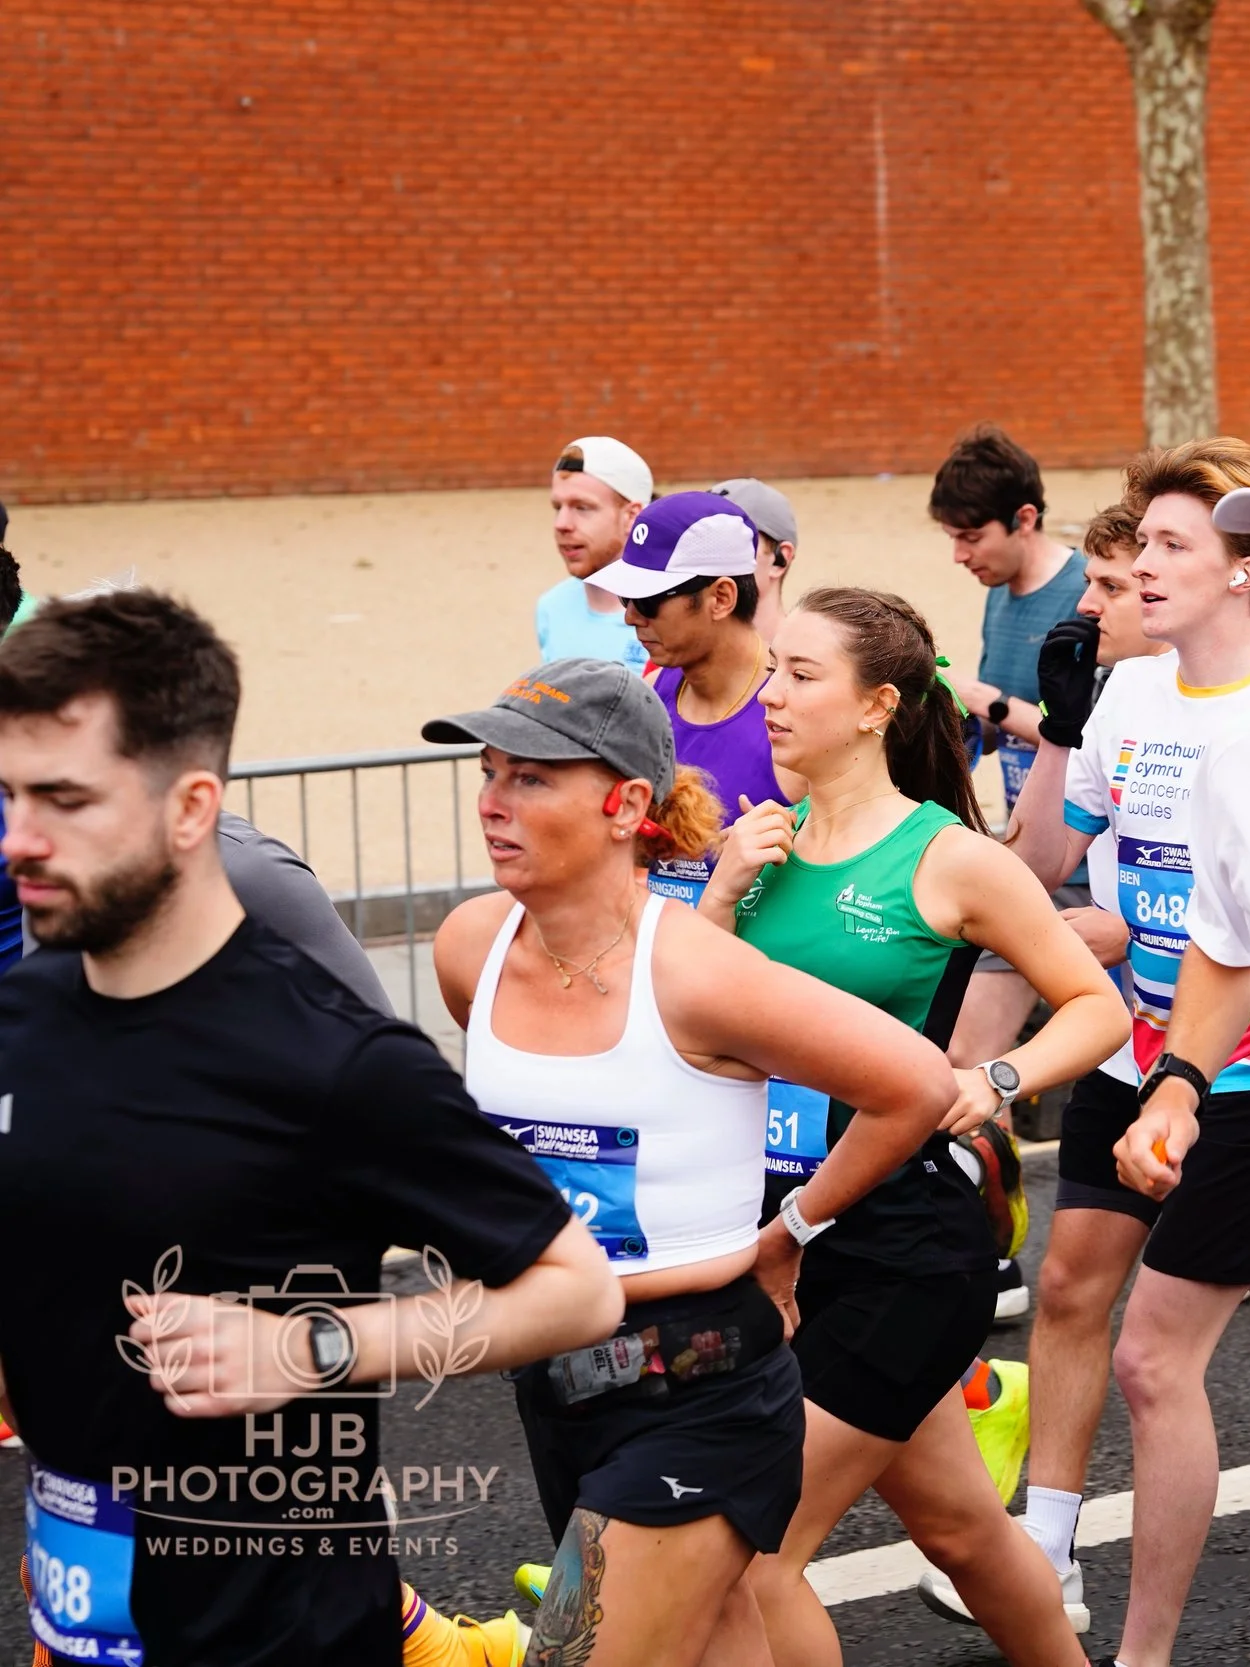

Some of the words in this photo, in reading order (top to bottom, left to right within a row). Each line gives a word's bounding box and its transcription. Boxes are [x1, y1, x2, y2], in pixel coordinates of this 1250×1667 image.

[1140, 741, 1206, 760] ymchwil
[1135, 761, 1183, 778] cymru
[1129, 781, 1181, 799] cancer
[1127, 801, 1172, 819] wales
[1119, 869, 1140, 887] BEN
[648, 879, 694, 900] FANGZHOU
[857, 893, 873, 902] Paul
[855, 898, 883, 911] Popham
[865, 910, 881, 923] Club
[856, 925, 878, 935] Learn
[879, 927, 885, 935] 2
[537, 1124, 599, 1144] SWANSEA
[593, 1348, 606, 1373] GEL
